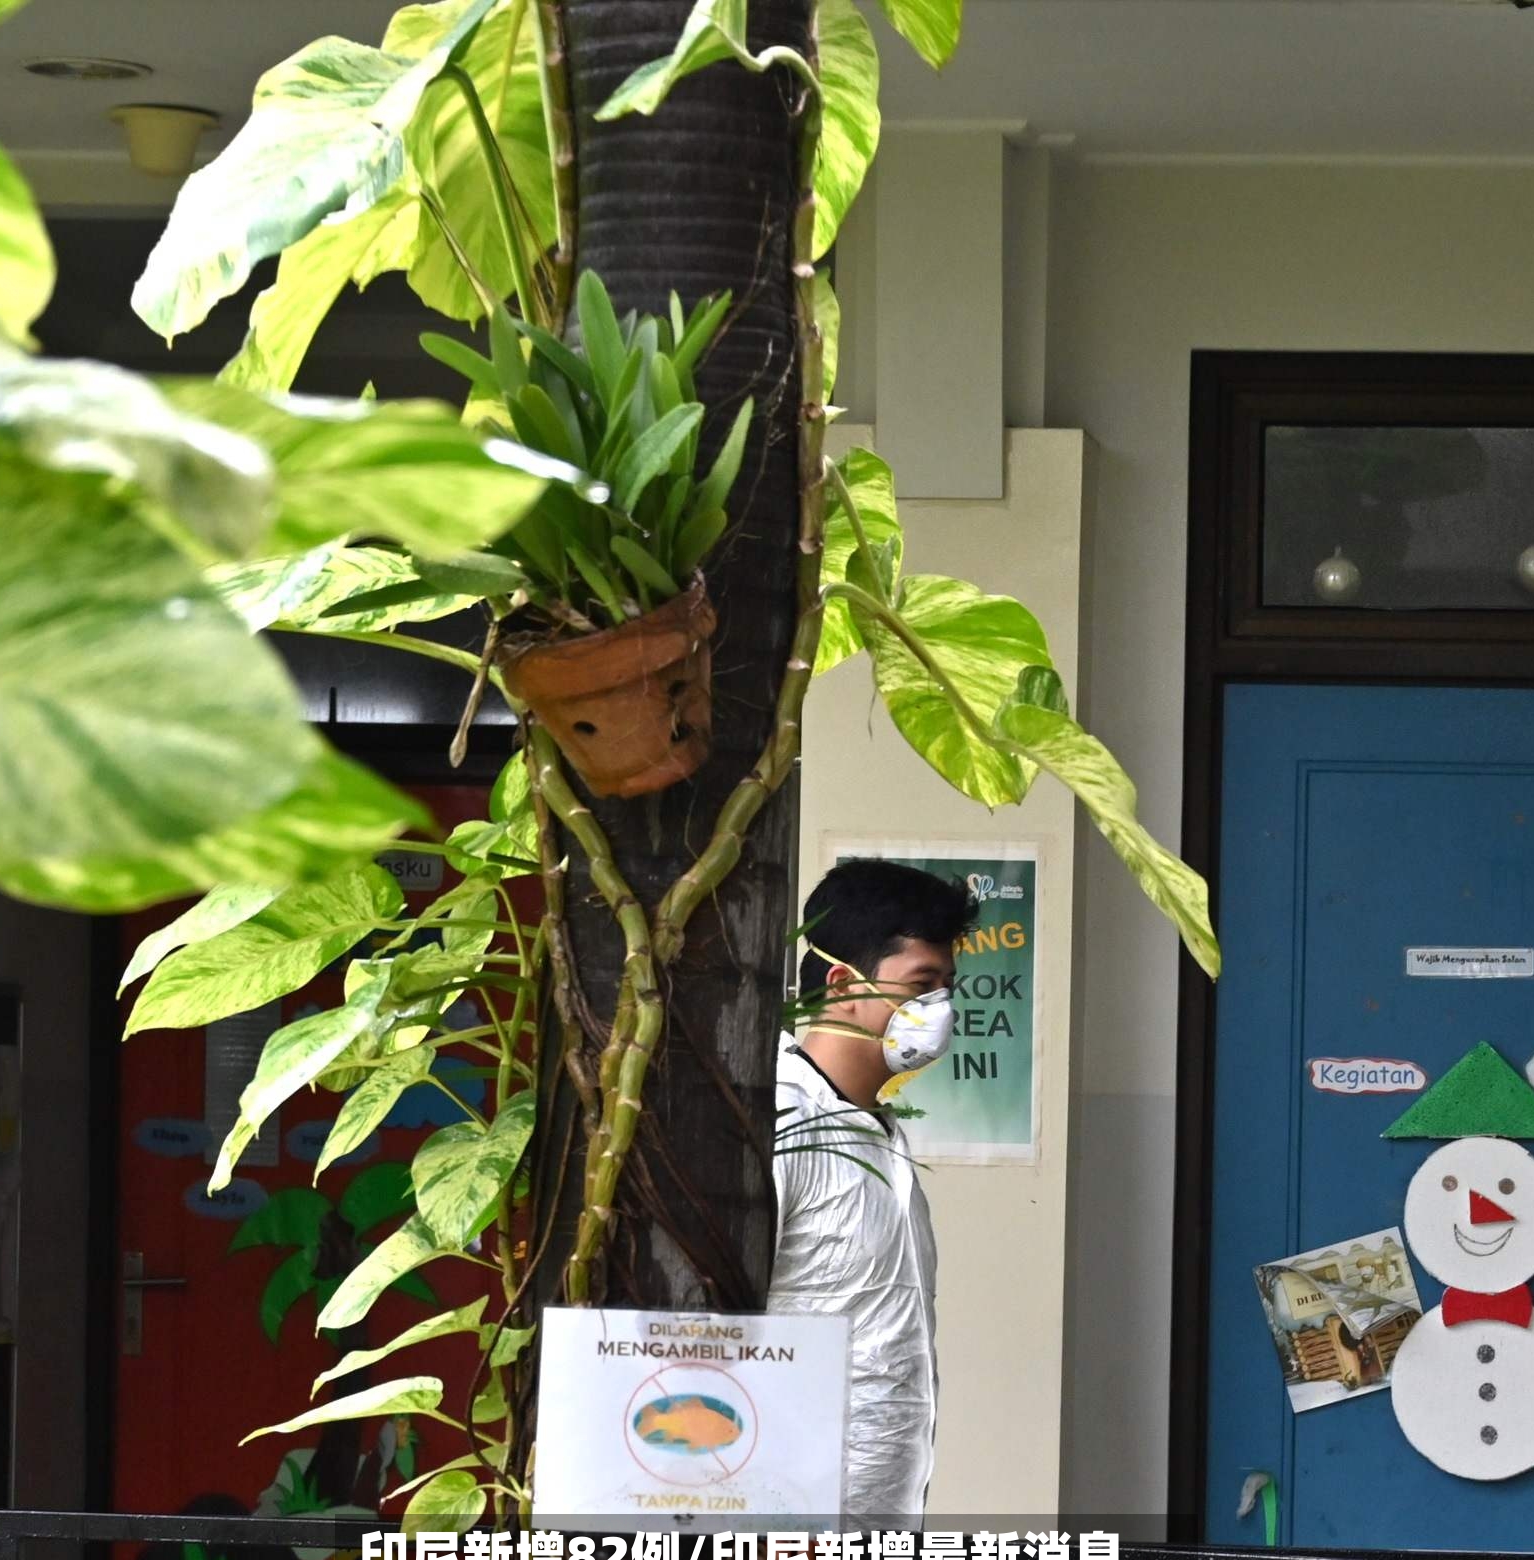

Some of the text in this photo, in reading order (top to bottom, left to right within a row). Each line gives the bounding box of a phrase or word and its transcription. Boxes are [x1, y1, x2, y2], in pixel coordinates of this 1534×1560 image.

[1416, 953, 1441, 965] Wajib
[953, 1051, 999, 1081] INI
[1320, 1063, 1416, 1090] Kegiatan
[648, 1321, 745, 1341] DILARANG
[596, 1340, 795, 1362] MENGAMBIL IKAN
[634, 1493, 747, 1511] TANPA IZIN
